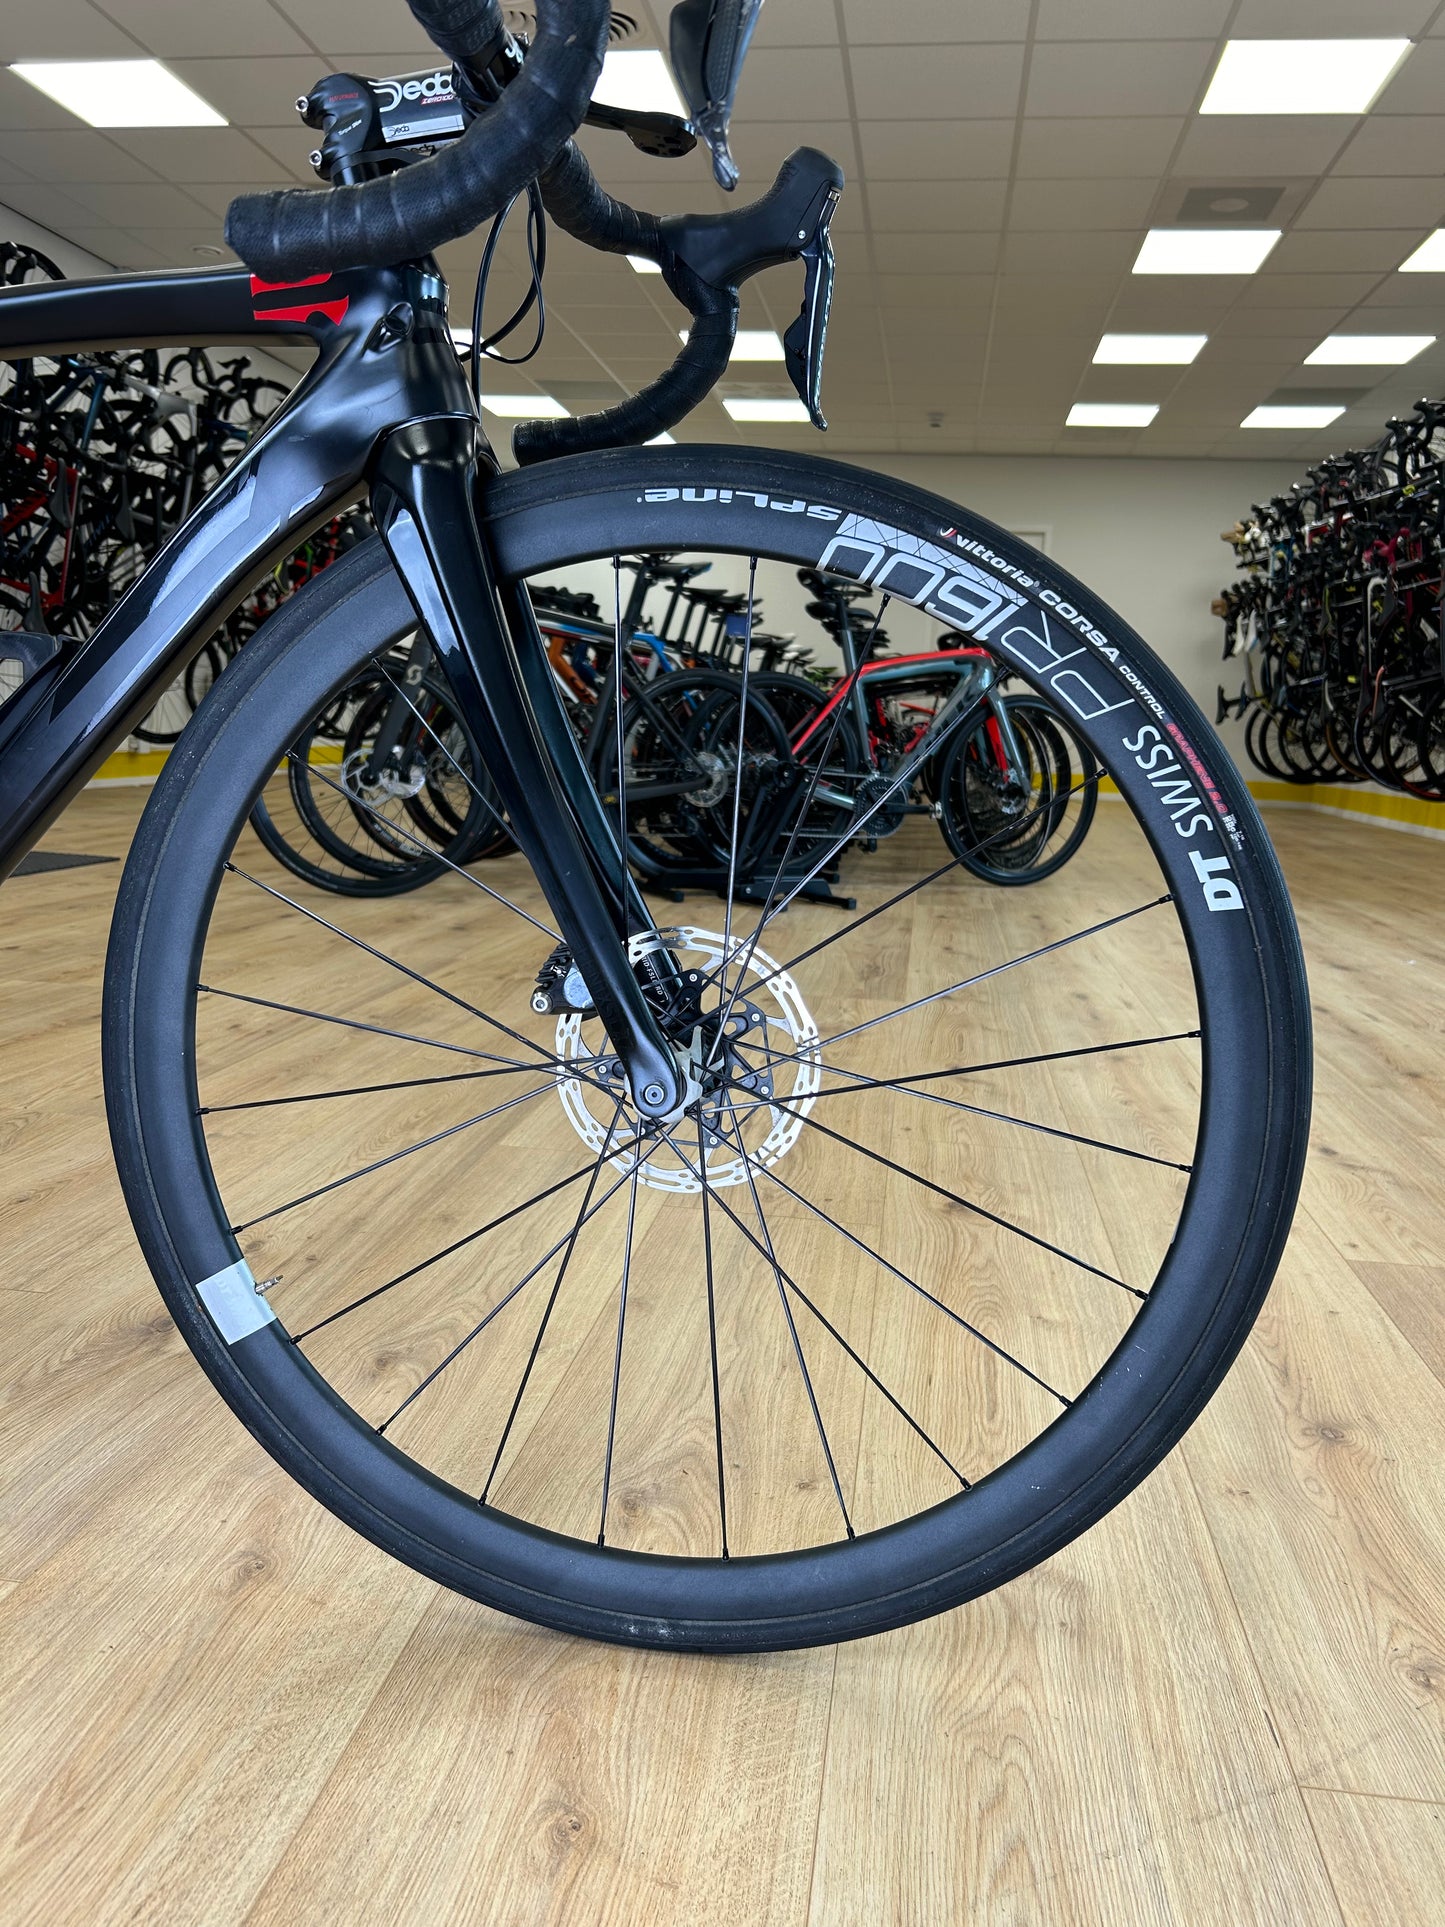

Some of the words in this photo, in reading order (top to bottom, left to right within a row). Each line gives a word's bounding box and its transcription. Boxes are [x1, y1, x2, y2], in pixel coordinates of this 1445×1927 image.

[1038, 589, 1120, 663] CORSA
[1118, 664, 1166, 720] CONTROL
[1165, 722, 1216, 790] GRAPHENE
[1121, 725, 1214, 839] SWISS
[1188, 850, 1245, 912] DT
